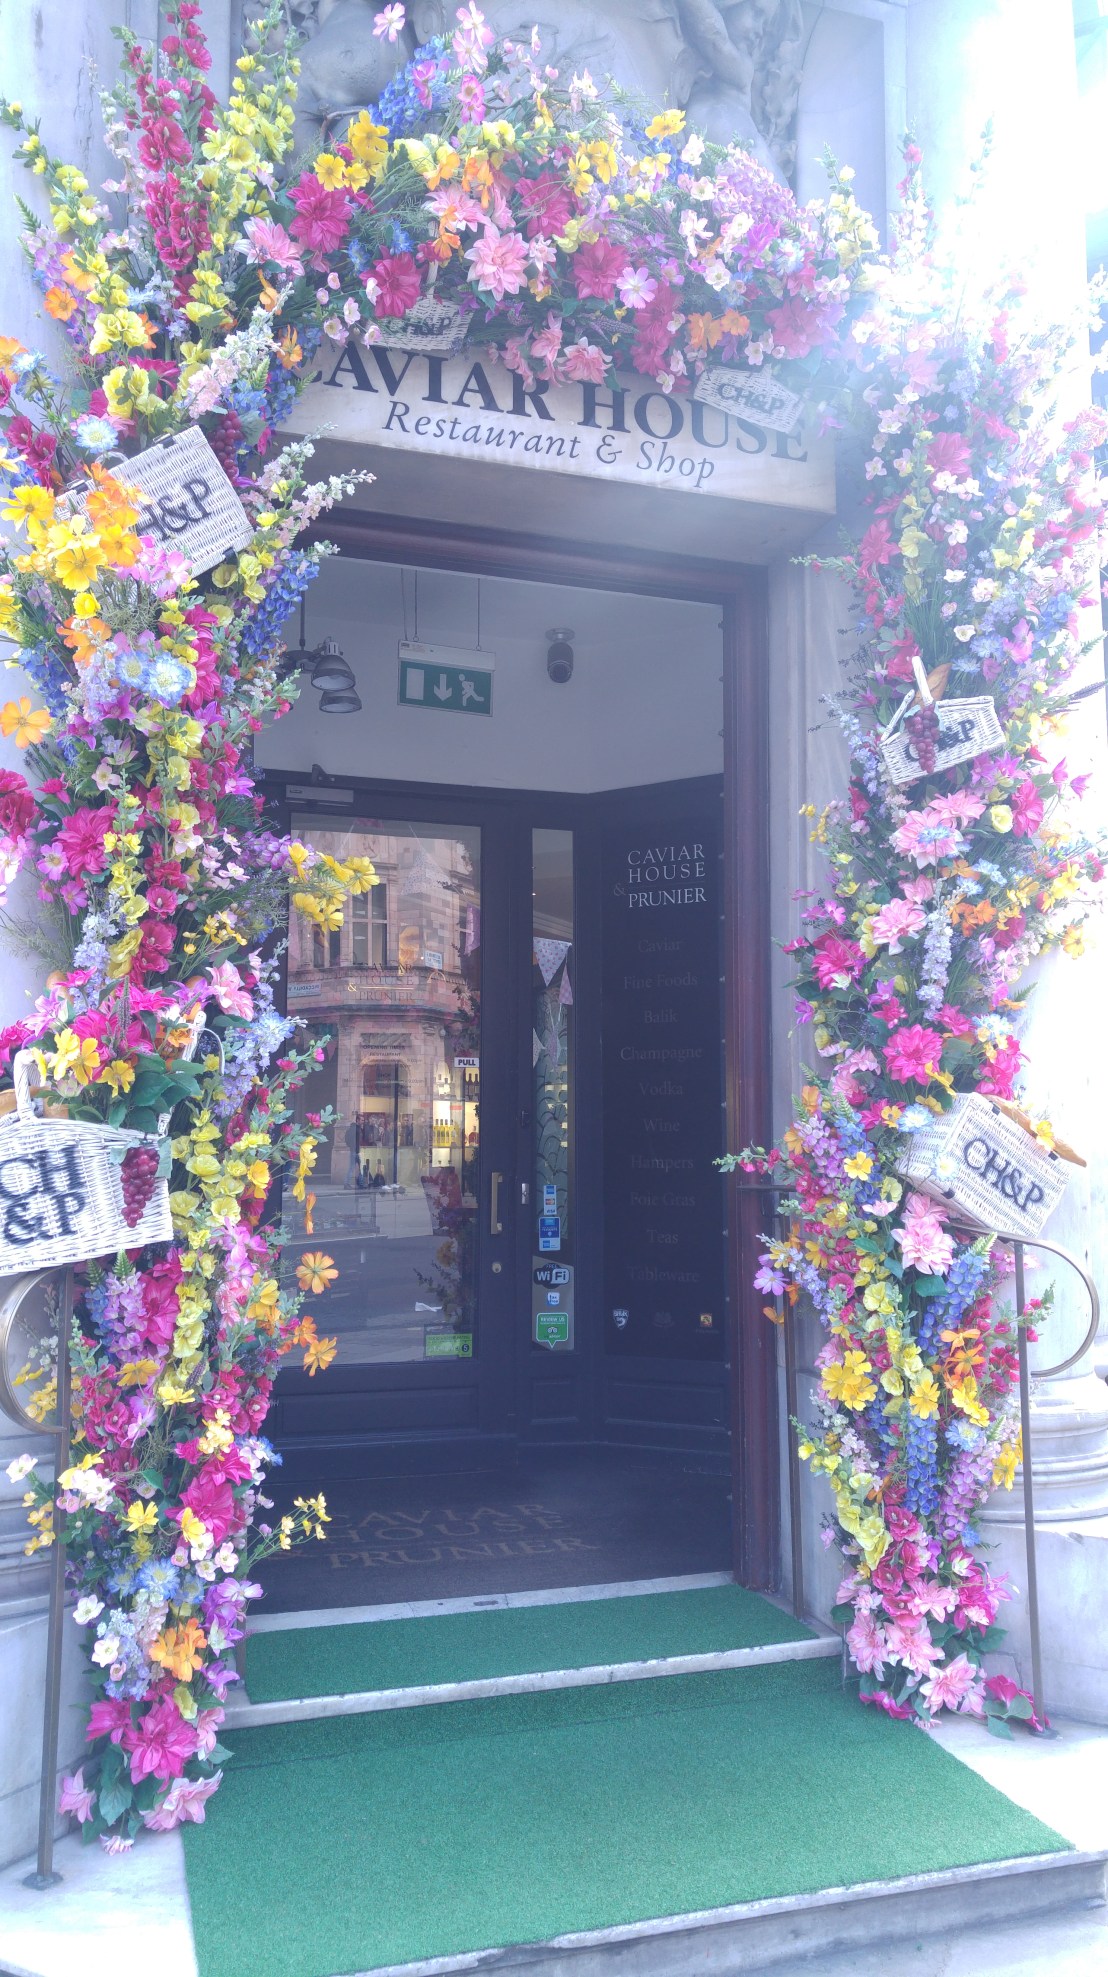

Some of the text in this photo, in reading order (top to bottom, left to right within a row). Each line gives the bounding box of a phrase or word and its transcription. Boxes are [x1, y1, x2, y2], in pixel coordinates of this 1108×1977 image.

[717, 383, 785, 415] CH&P
[577, 380, 808, 463] HOUSE
[382, 401, 715, 488] Restaurant & Shop
[136, 479, 212, 541] H&P
[904, 719, 976, 762] C&P
[627, 843, 705, 865] CAVIAR
[628, 862, 706, 884] HOUSE
[628, 888, 707, 908] PRUNIER
[638, 937, 683, 953] Caviar
[624, 972, 698, 989] Fine Foods
[643, 1009, 679, 1024] Balik
[620, 1046, 703, 1063] Champagne
[639, 1081, 683, 1096] Vodka
[643, 1118, 680, 1133] Wine
[630, 1154, 694, 1174] Hampers
[963, 1136, 1044, 1212] CH&P
[663, 1192, 696, 1207] Gras
[647, 1229, 679, 1245] Teas
[628, 1266, 700, 1283] Tableware
[331, 1537, 600, 1569] PRUNIER
